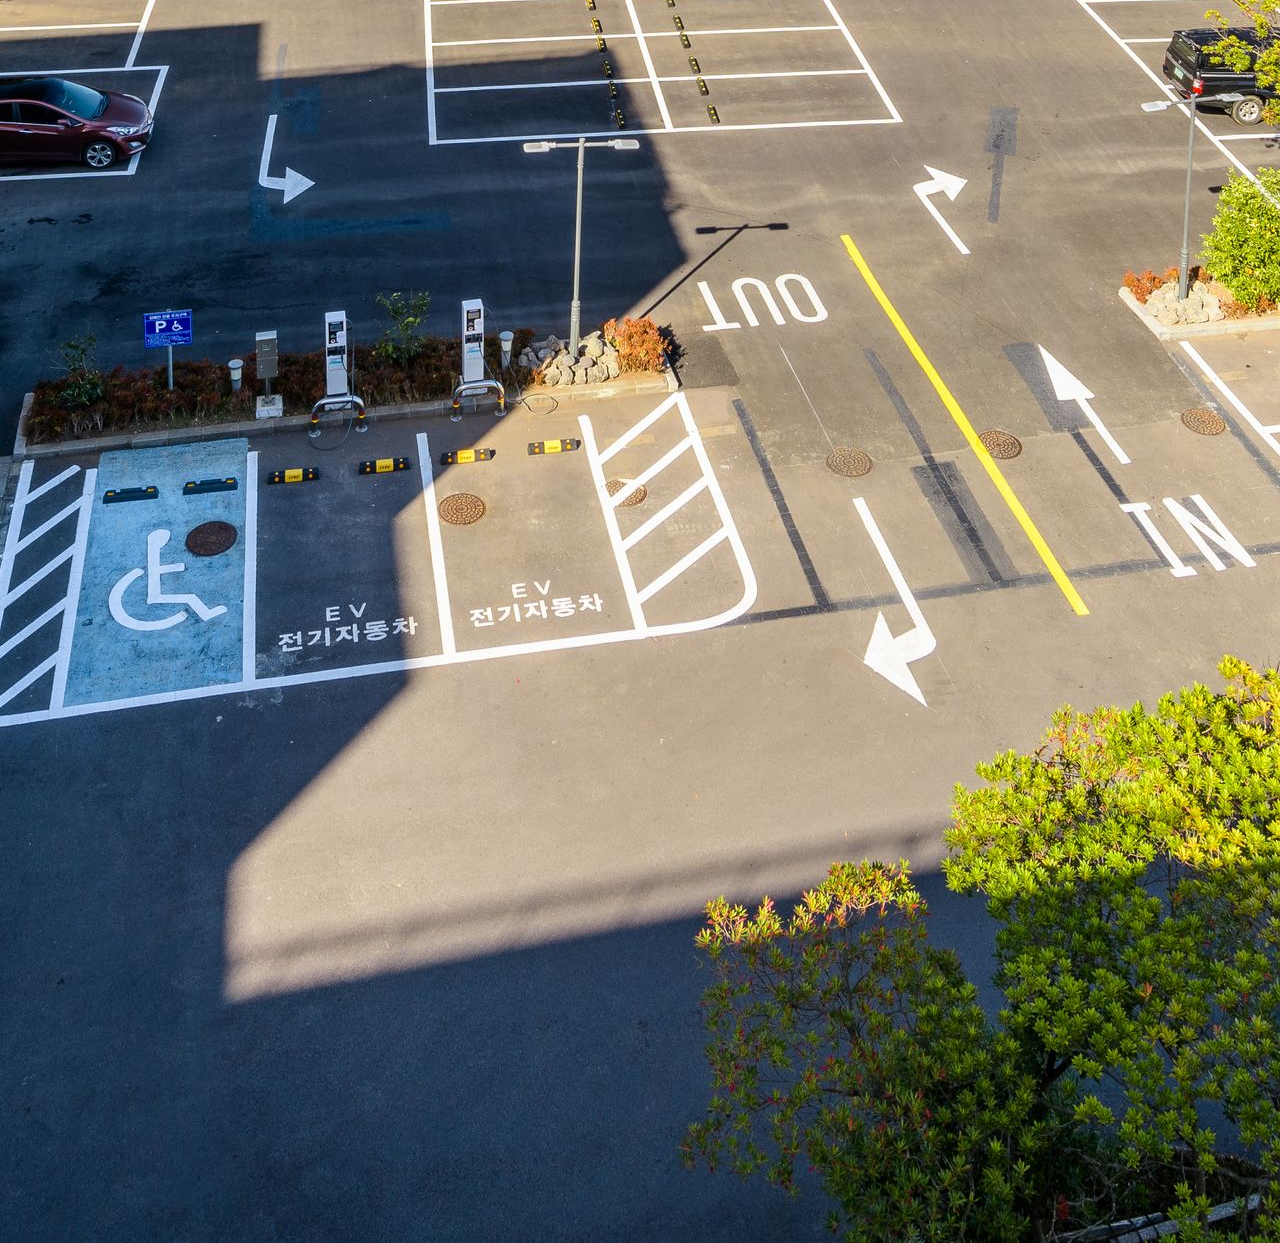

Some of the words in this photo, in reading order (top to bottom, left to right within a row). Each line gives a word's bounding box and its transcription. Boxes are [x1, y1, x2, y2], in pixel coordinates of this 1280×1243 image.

[697, 273, 828, 332] OUT
[155, 320, 167, 333] P
[1119, 494, 1257, 578] IN
[469, 592, 604, 628] 전기자동차
[277, 615, 419, 652] 전기자동차
